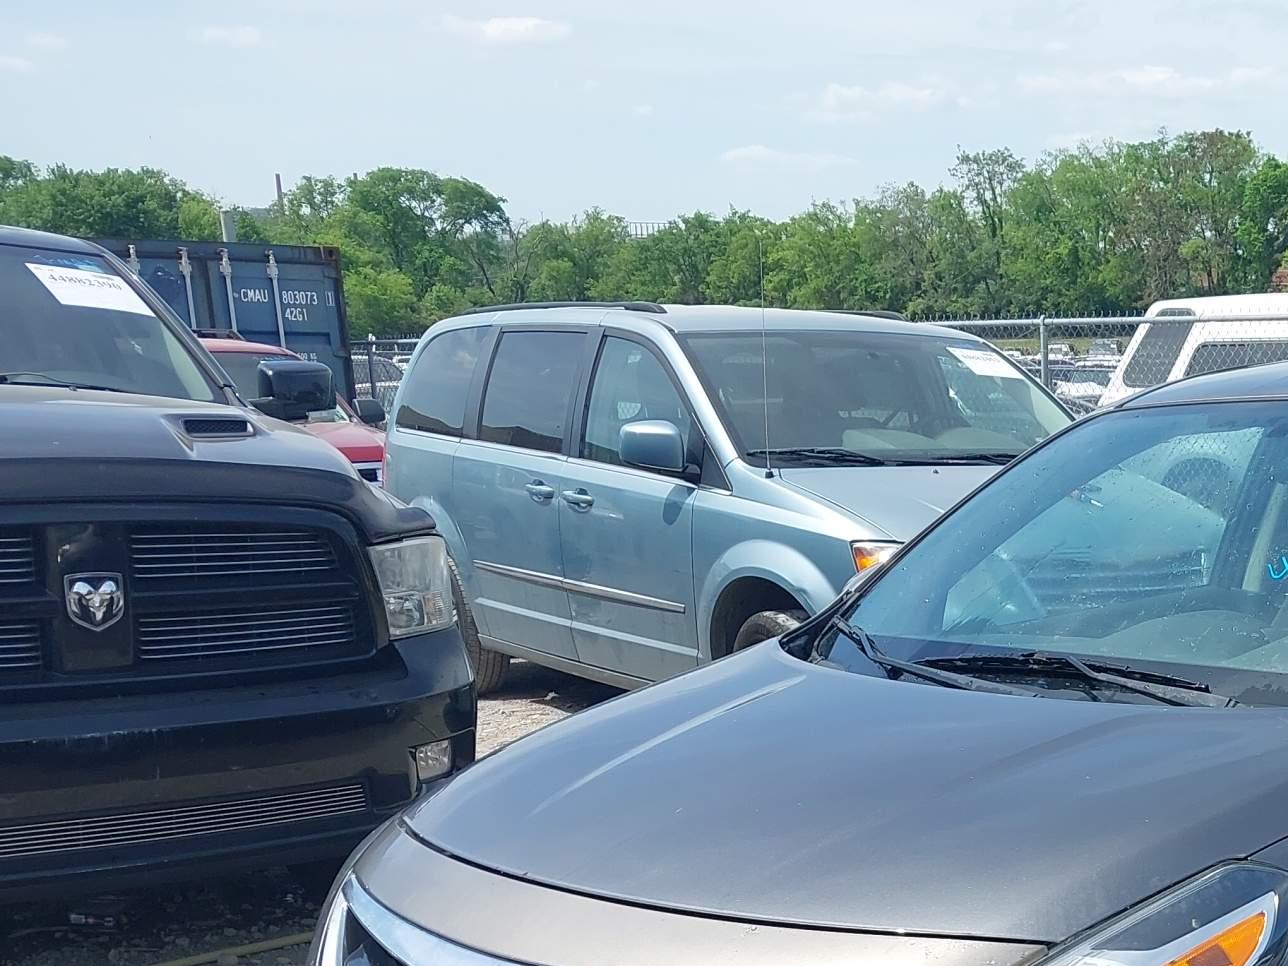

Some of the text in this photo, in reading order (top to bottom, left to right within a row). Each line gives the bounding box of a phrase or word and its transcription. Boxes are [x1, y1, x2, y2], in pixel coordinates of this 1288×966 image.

[240, 288, 269, 303] CMAU
[281, 290, 318, 305] 803073
[285, 308, 308, 321] 42G1
